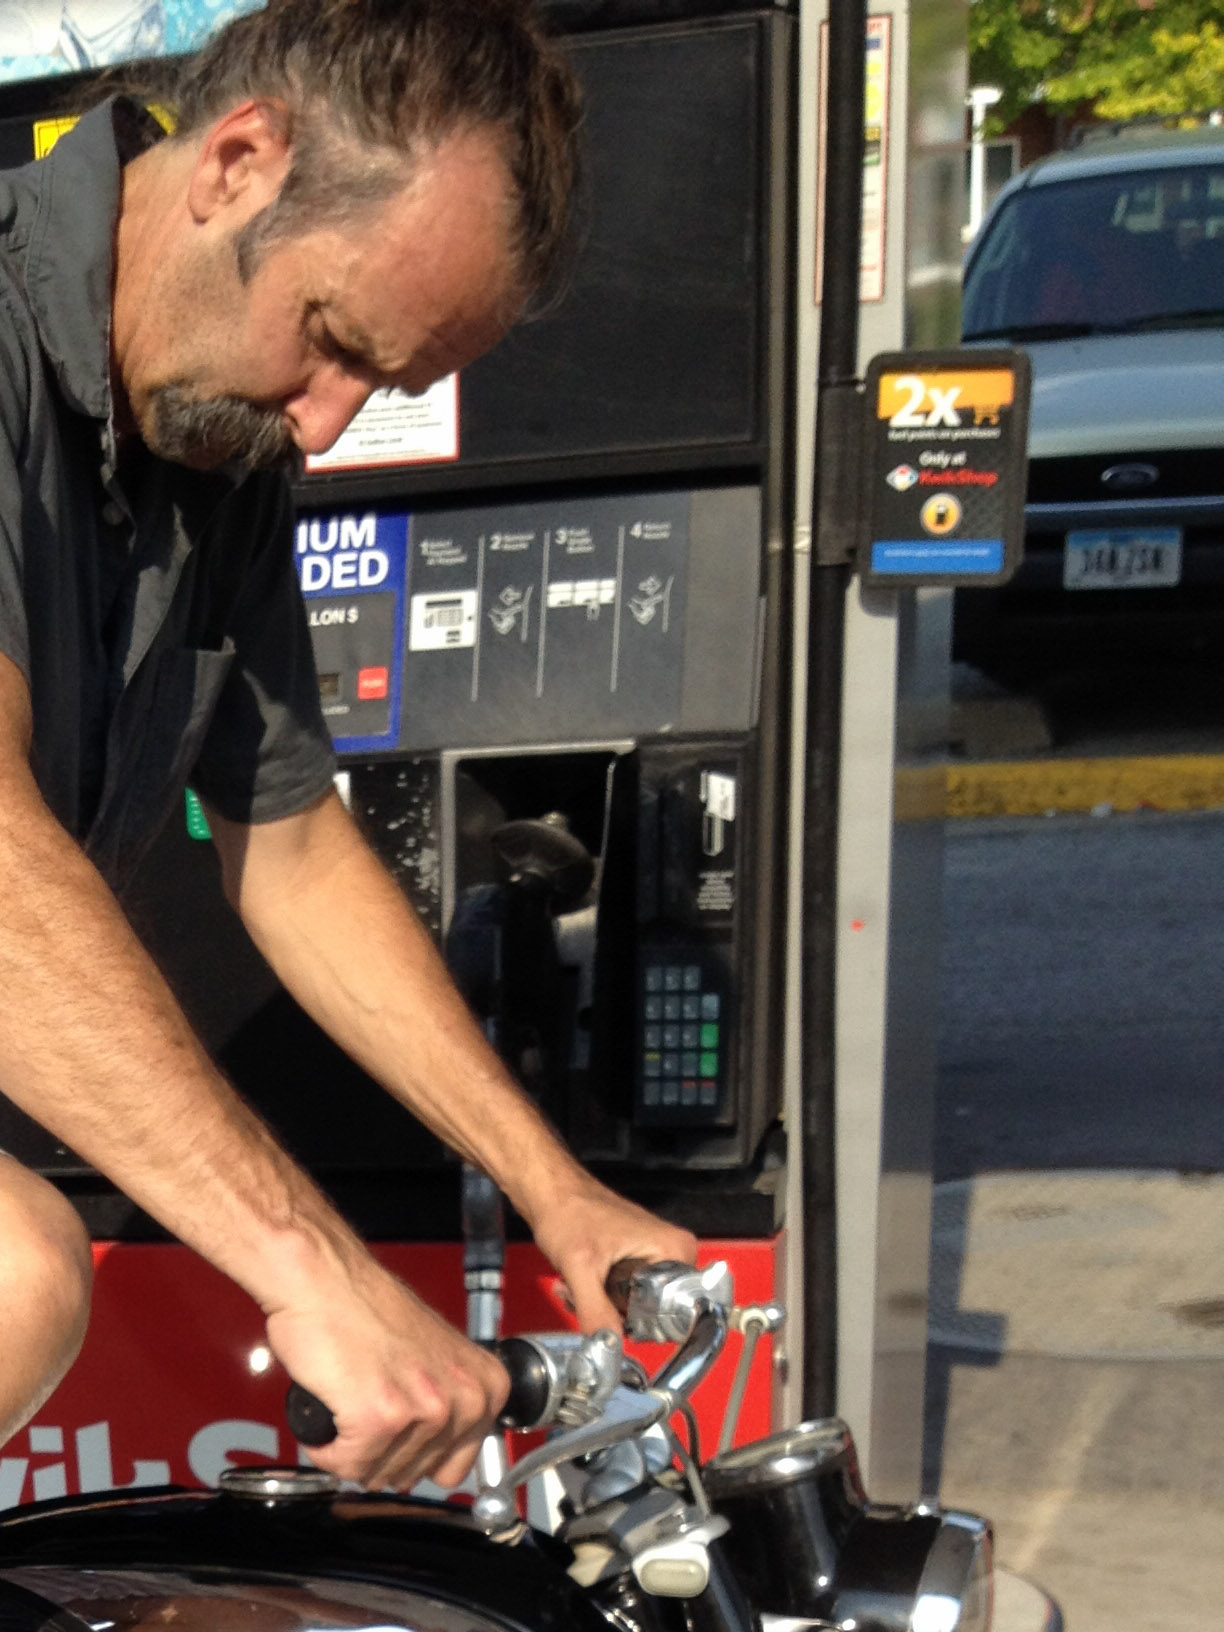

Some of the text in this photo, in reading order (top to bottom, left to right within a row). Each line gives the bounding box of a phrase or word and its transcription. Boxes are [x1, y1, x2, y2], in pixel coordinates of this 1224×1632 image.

[889, 373, 963, 428] 2x
[490, 532, 502, 551] 2
[555, 526, 568, 545] 3
